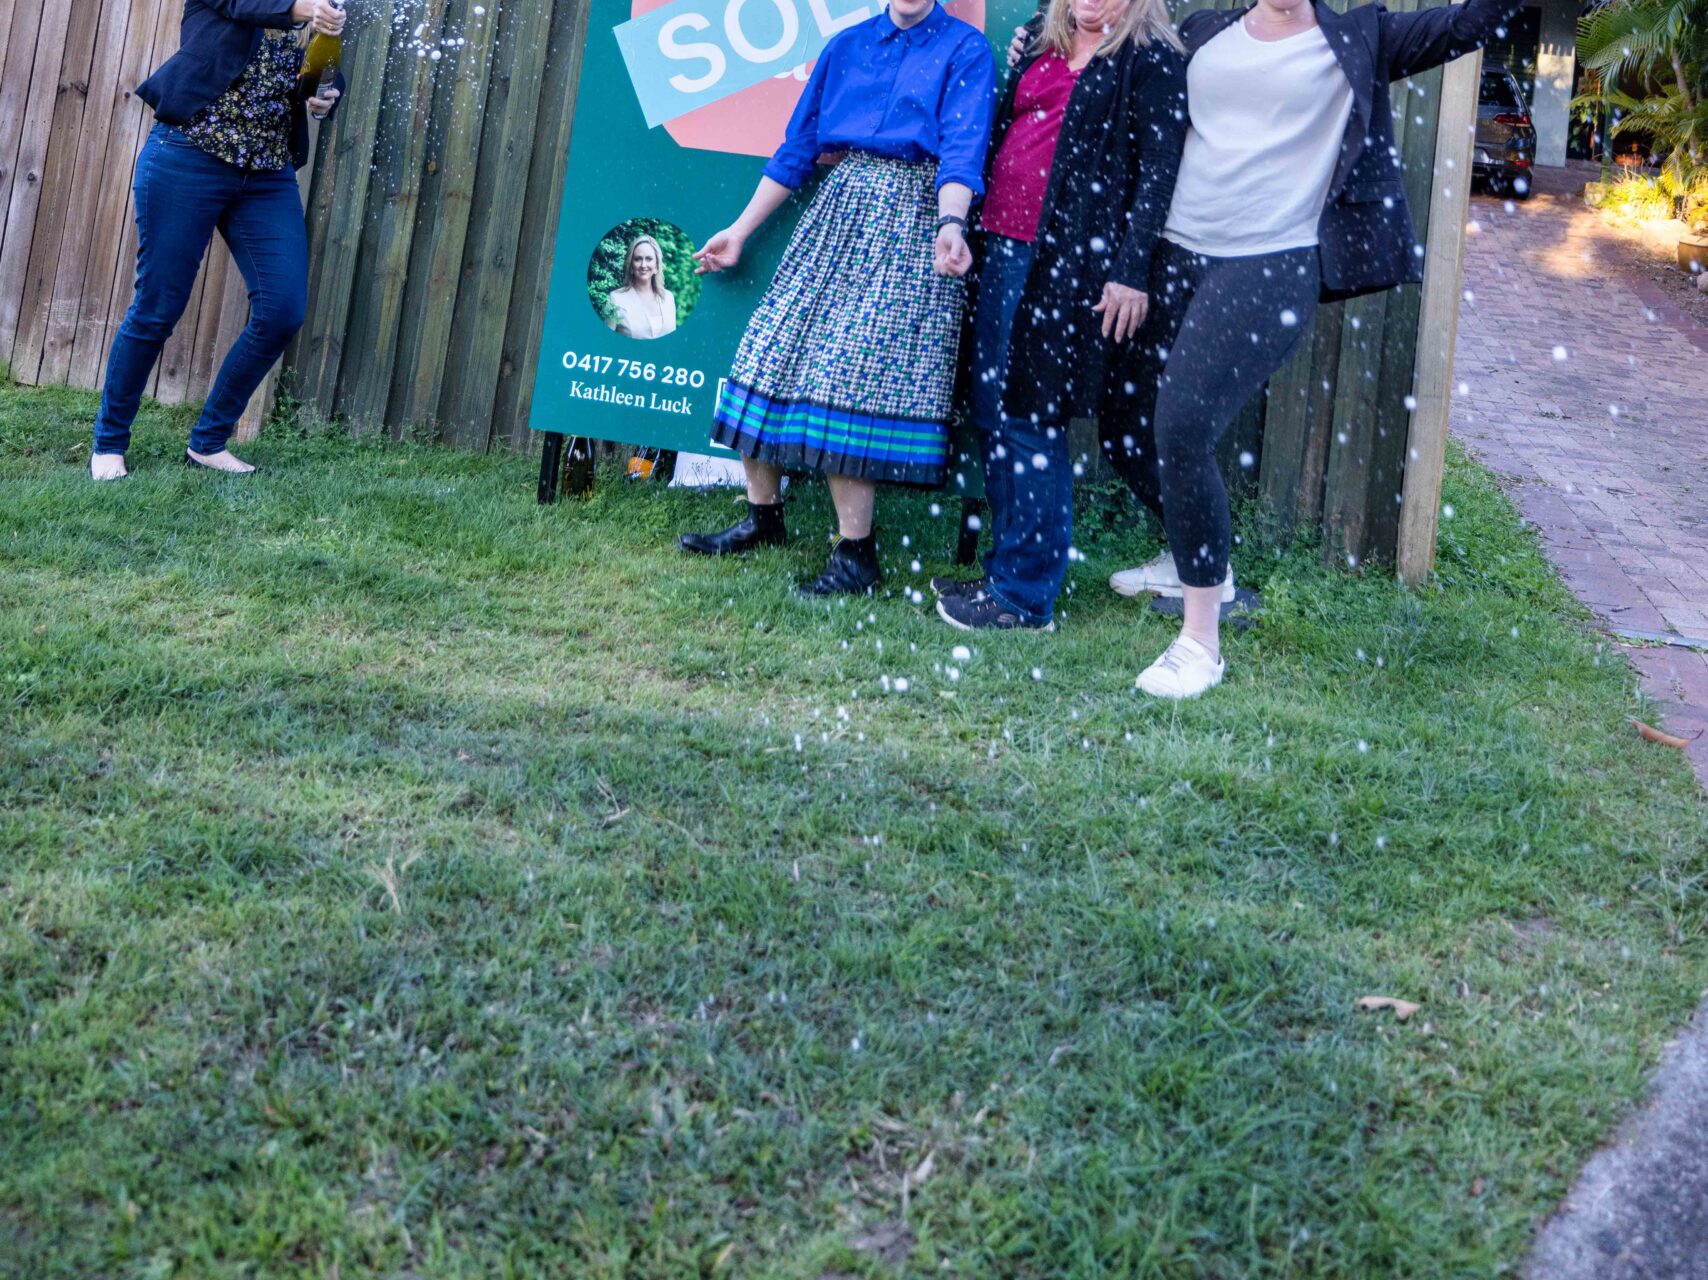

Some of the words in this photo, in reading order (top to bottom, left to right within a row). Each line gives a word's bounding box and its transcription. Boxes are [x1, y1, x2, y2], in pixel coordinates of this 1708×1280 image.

[562, 351, 612, 374] 0417
[617, 359, 656, 380] 756
[661, 366, 705, 388] 280
[569, 381, 645, 408] Kathleen
[650, 393, 692, 415] Luck
